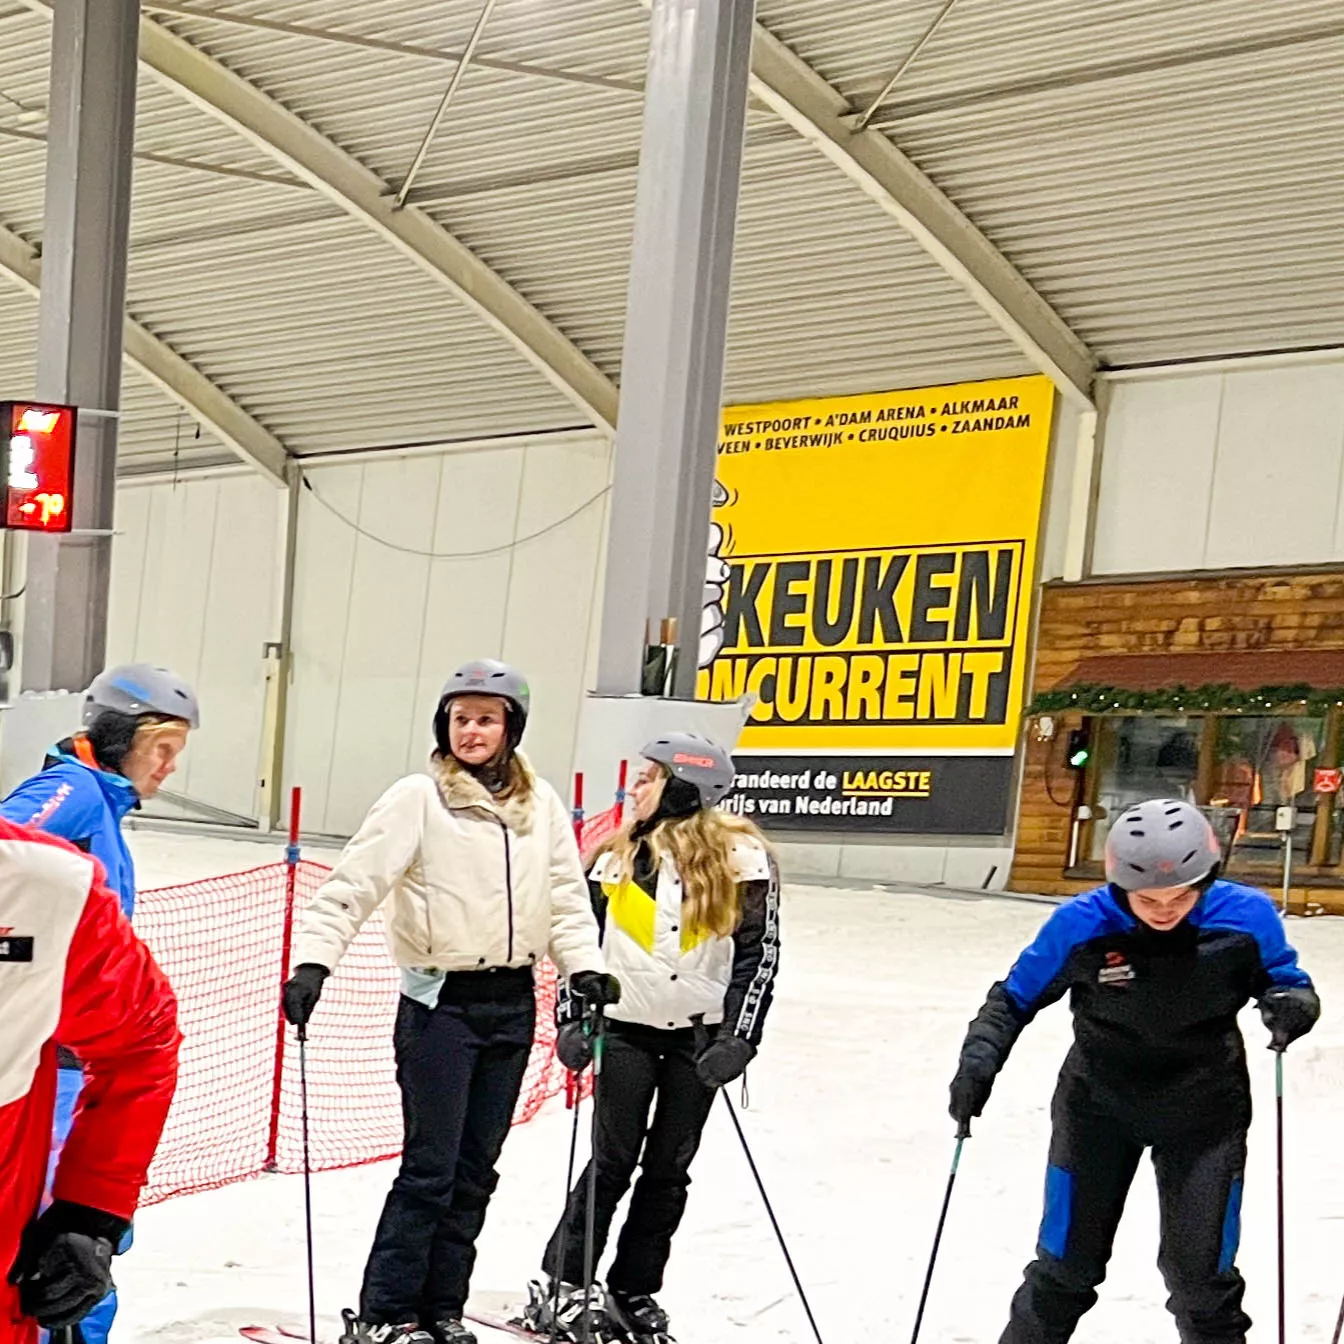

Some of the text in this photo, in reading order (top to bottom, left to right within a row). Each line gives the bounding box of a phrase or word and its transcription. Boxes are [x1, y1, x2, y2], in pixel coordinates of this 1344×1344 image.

[724, 396, 1019, 437] WESTPOORT A'DAM ARENA ALKMAAR
[765, 431, 844, 450] BEVERWIJK
[859, 422, 936, 442] CRUQUIUS
[952, 414, 1031, 434] ZAANDAM
[723, 549, 1014, 648] KEUKEN
[814, 771, 837, 790] de
[842, 772, 932, 790] LAAGSTE
[758, 799, 791, 813] van
[795, 797, 894, 815] Nederland
